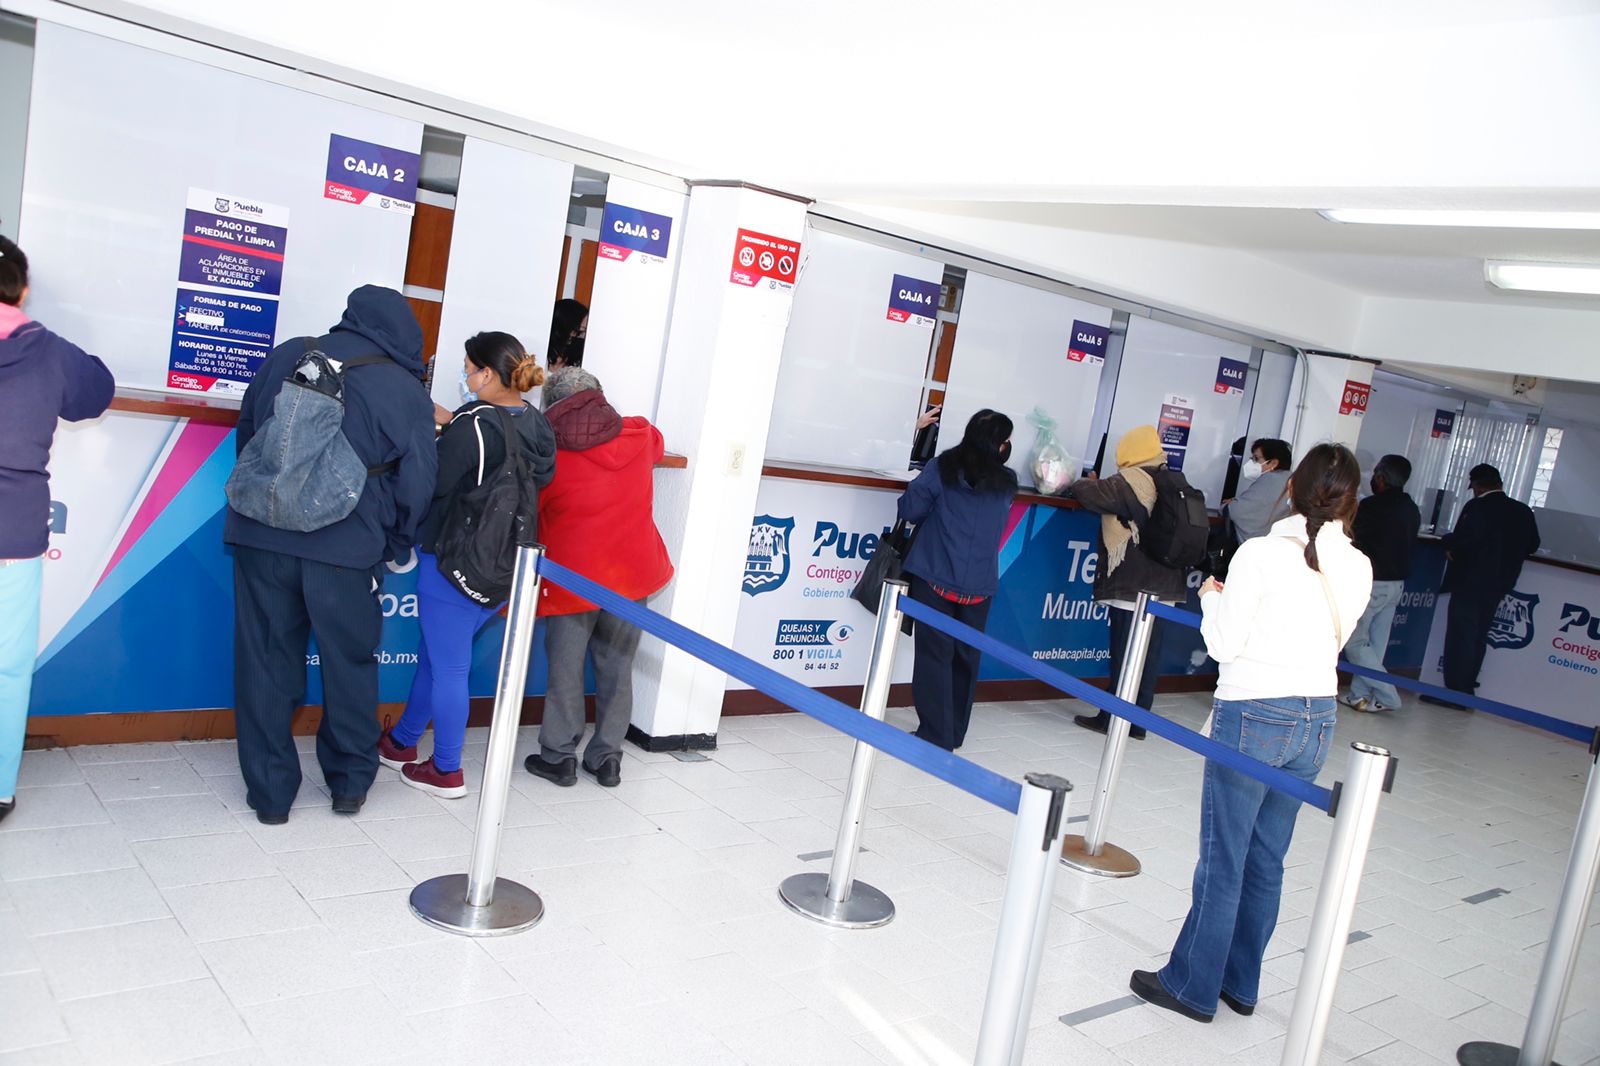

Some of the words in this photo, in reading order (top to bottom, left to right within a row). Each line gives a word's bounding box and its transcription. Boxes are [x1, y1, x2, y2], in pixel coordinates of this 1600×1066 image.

[344, 156, 388, 179] CAJA
[394, 168, 404, 182] 2
[234, 202, 263, 214] Puebla
[216, 220, 242, 231] PAGO
[244, 225, 258, 234] DE
[614, 220, 648, 238] CAJA
[650, 229, 660, 240] 3
[194, 226, 234, 240] PREDIAL
[245, 236, 276, 248] LIMPIA
[198, 258, 254, 274] ACLARACIONES
[218, 252, 237, 263] ÁREA
[239, 258, 248, 266] DE
[202, 266, 211, 274] EL
[213, 268, 250, 280] INMUEBLE
[220, 276, 254, 288] ACUARIO
[194, 296, 226, 307] FORMAS
[240, 302, 262, 312] PAGO
[899, 289, 922, 303] CAJA
[925, 296, 931, 305] 4
[189, 306, 224, 318] EFECTIVO
[188, 321, 219, 332] TARJETA
[1077, 332, 1095, 344] CAJA
[1097, 338, 1102, 346] 5
[179, 340, 214, 351] HORARIO
[228, 346, 266, 358] ATENCIÓN
[196, 350, 217, 358] Lunes
[224, 354, 248, 362] Viernes
[175, 361, 200, 371] Sábado
[202, 364, 211, 372] de
[212, 366, 226, 374] 9:00
[235, 368, 252, 377] 14:00
[194, 357, 210, 365] 8:00
[217, 359, 235, 367] 18:00
[236, 362, 248, 370] hrs.
[172, 374, 198, 384] Contigo
[1223, 368, 1237, 378] CAJA
[180, 382, 203, 390] rumbo
[812, 521, 891, 560] Pue
[1068, 540, 1099, 584] Te
[806, 564, 852, 584] Contigo
[803, 587, 844, 598] Gobierno
[1400, 588, 1436, 608] orería
[781, 624, 813, 632] QUEJAS
[815, 624, 820, 632] Y
[1558, 602, 1600, 640] Pu
[779, 634, 825, 643] DENUNCIAS
[773, 649, 794, 660] 800
[798, 649, 804, 659] 1
[806, 649, 842, 659] VIGILA
[1548, 655, 1598, 675] Gobierno
